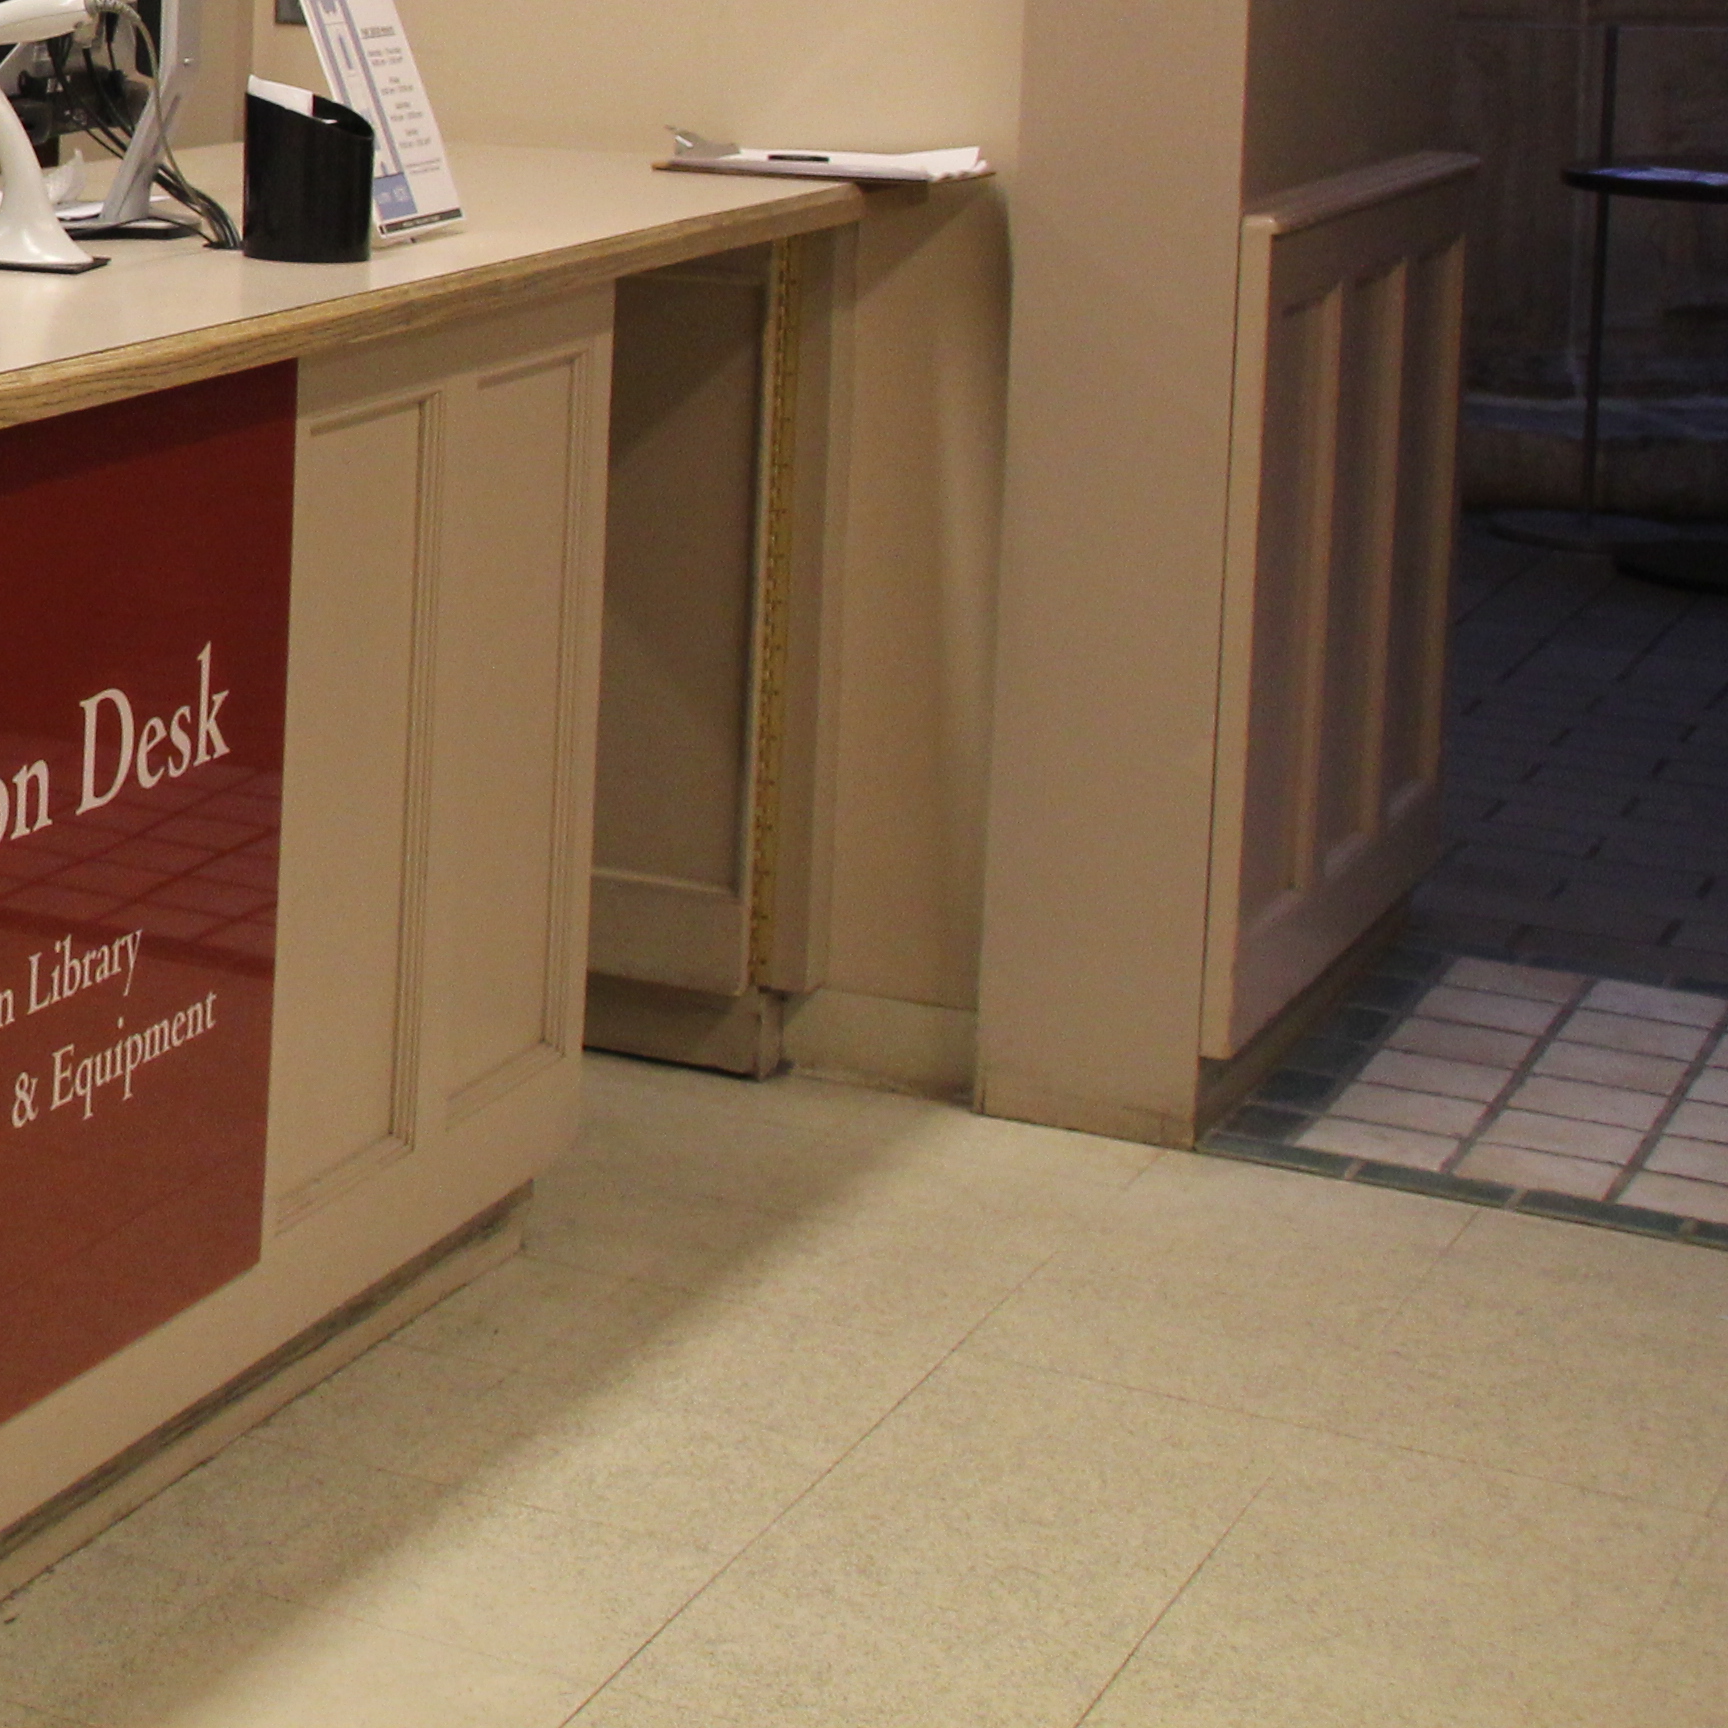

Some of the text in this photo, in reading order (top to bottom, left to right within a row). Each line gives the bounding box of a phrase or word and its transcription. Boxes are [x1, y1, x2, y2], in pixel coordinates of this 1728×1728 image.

[76, 643, 231, 818] Desk
[27, 928, 143, 1020] Library
[11, 1072, 37, 1128] &
[49, 986, 218, 1118] Equipment
